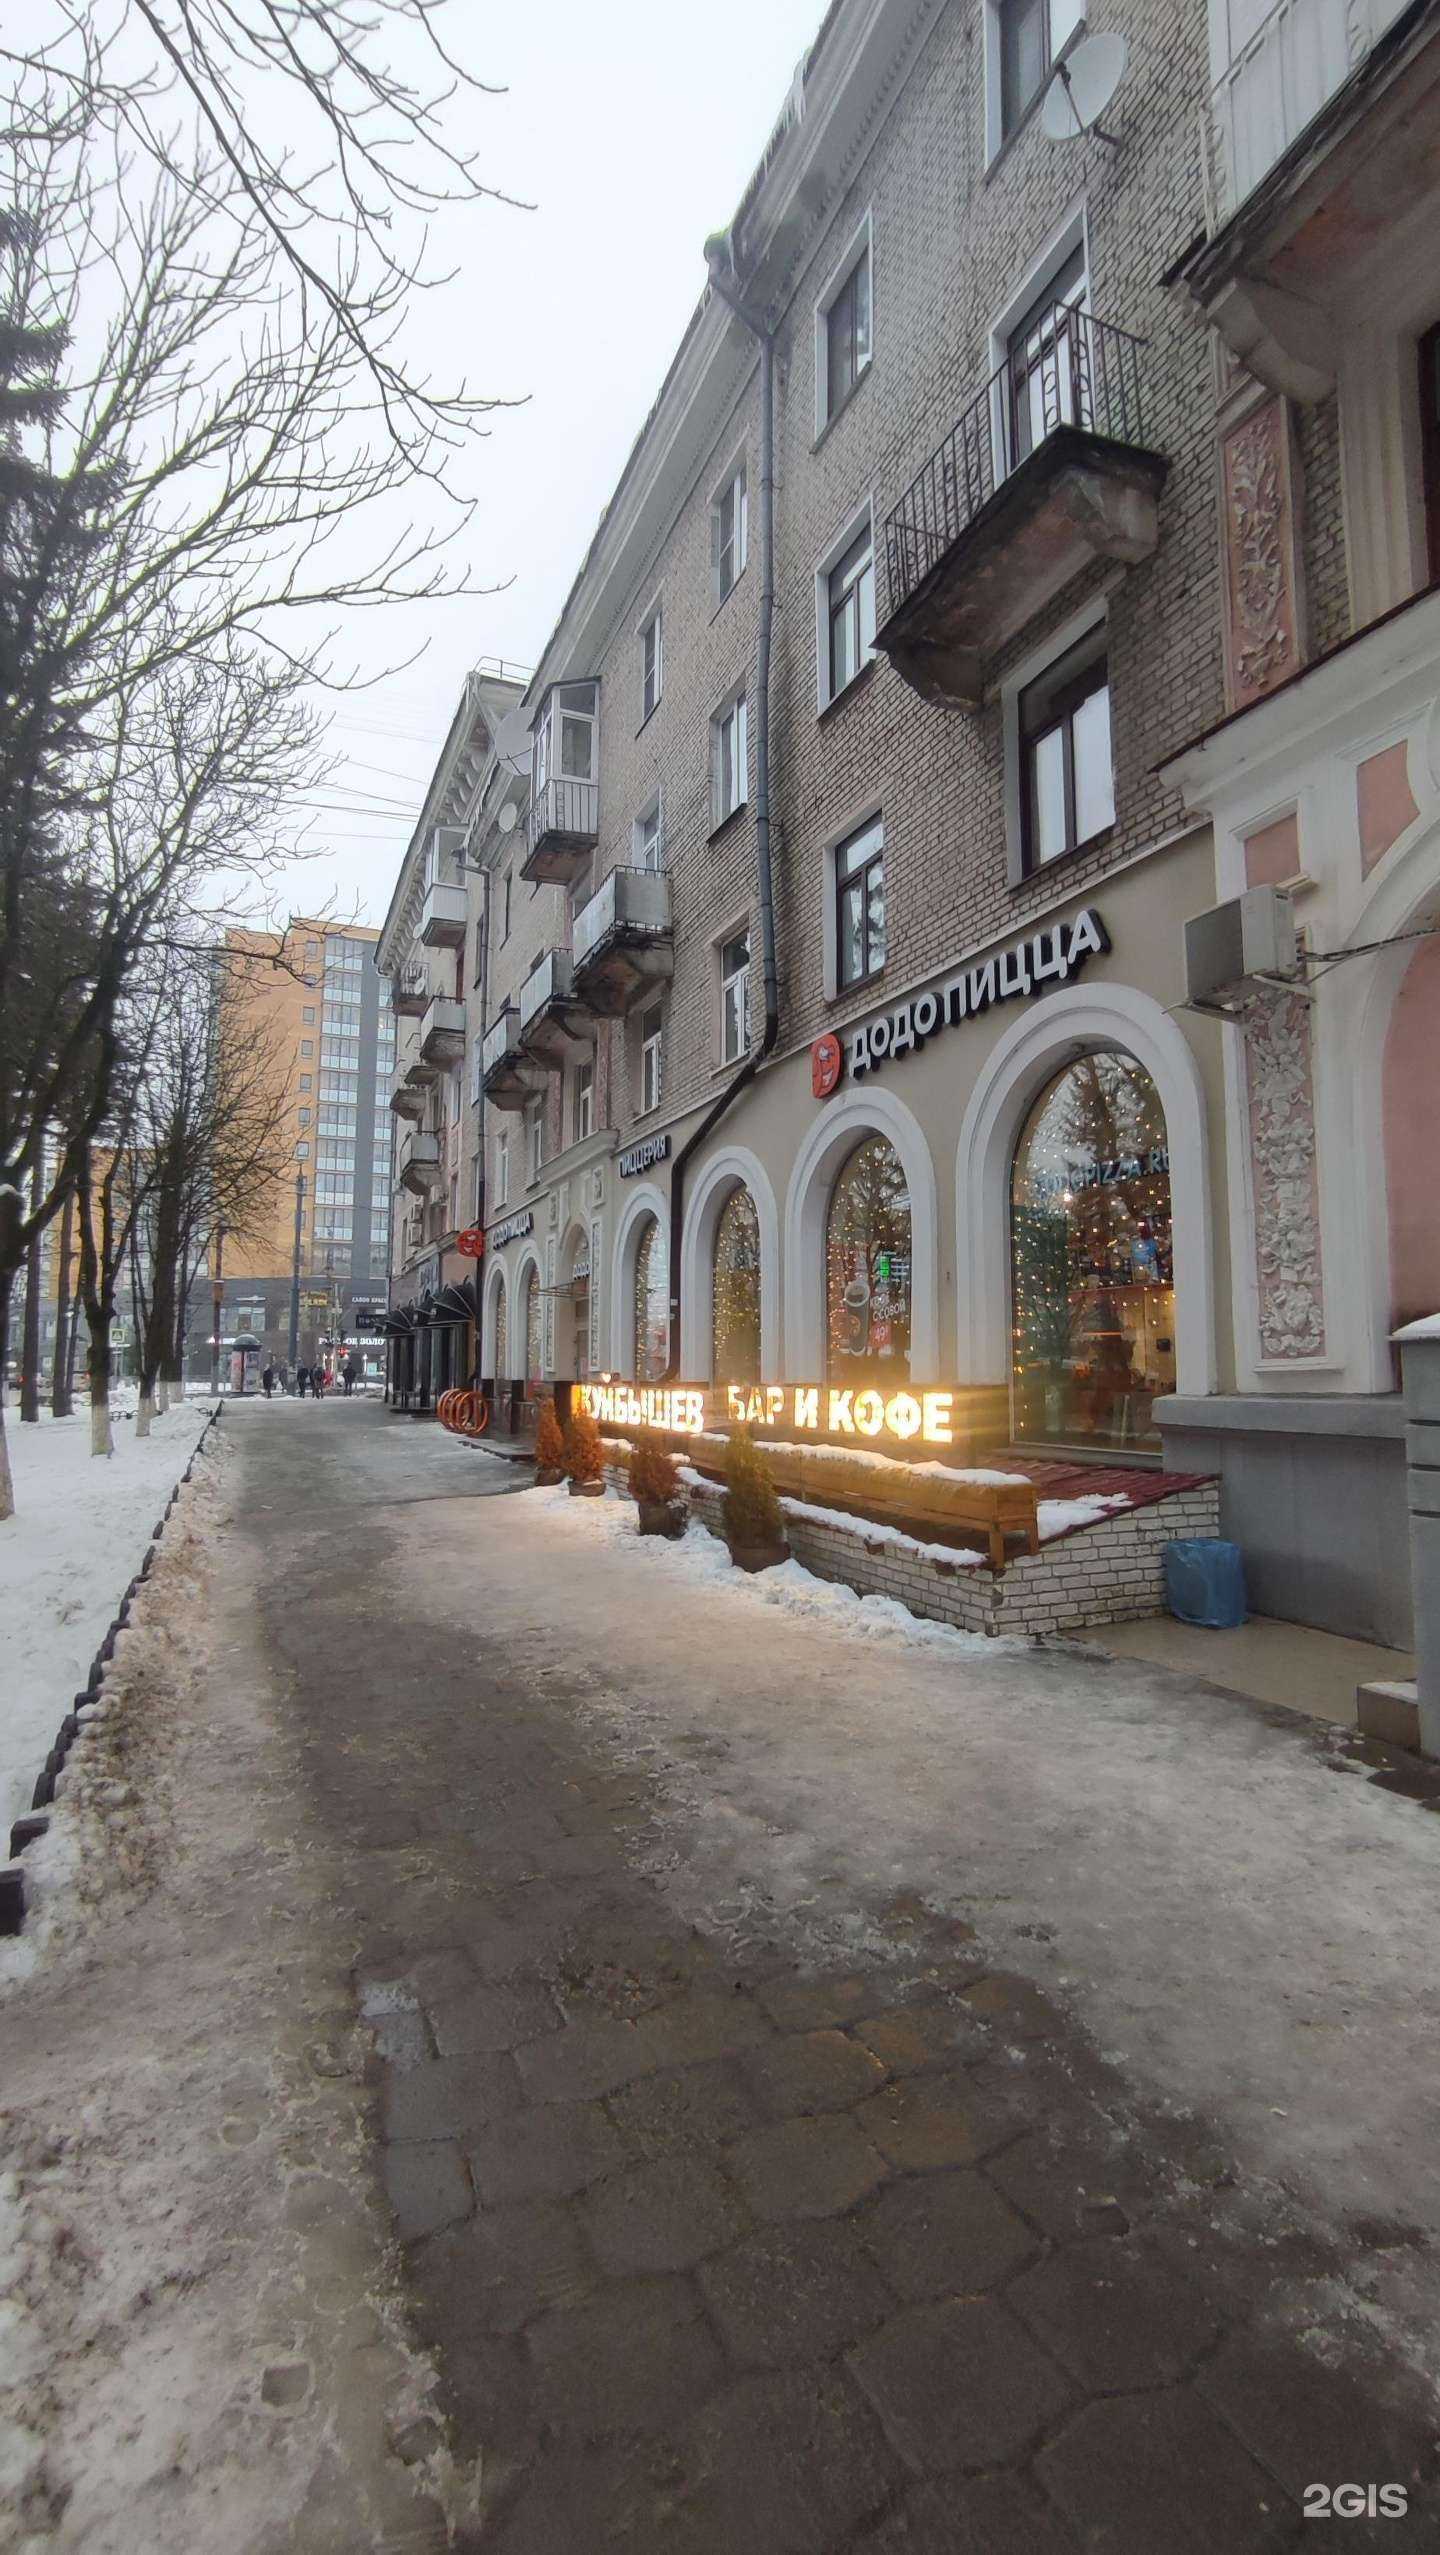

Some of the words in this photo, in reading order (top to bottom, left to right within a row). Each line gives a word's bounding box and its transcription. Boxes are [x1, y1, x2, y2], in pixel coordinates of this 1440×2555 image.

[849, 994, 938, 1079] ДОДО
[943, 909, 1104, 1025] ПИЦЦА
[727, 1385, 785, 1425] БАР
[794, 1387, 819, 1429] И
[828, 1388, 954, 1443] КОФЕ
